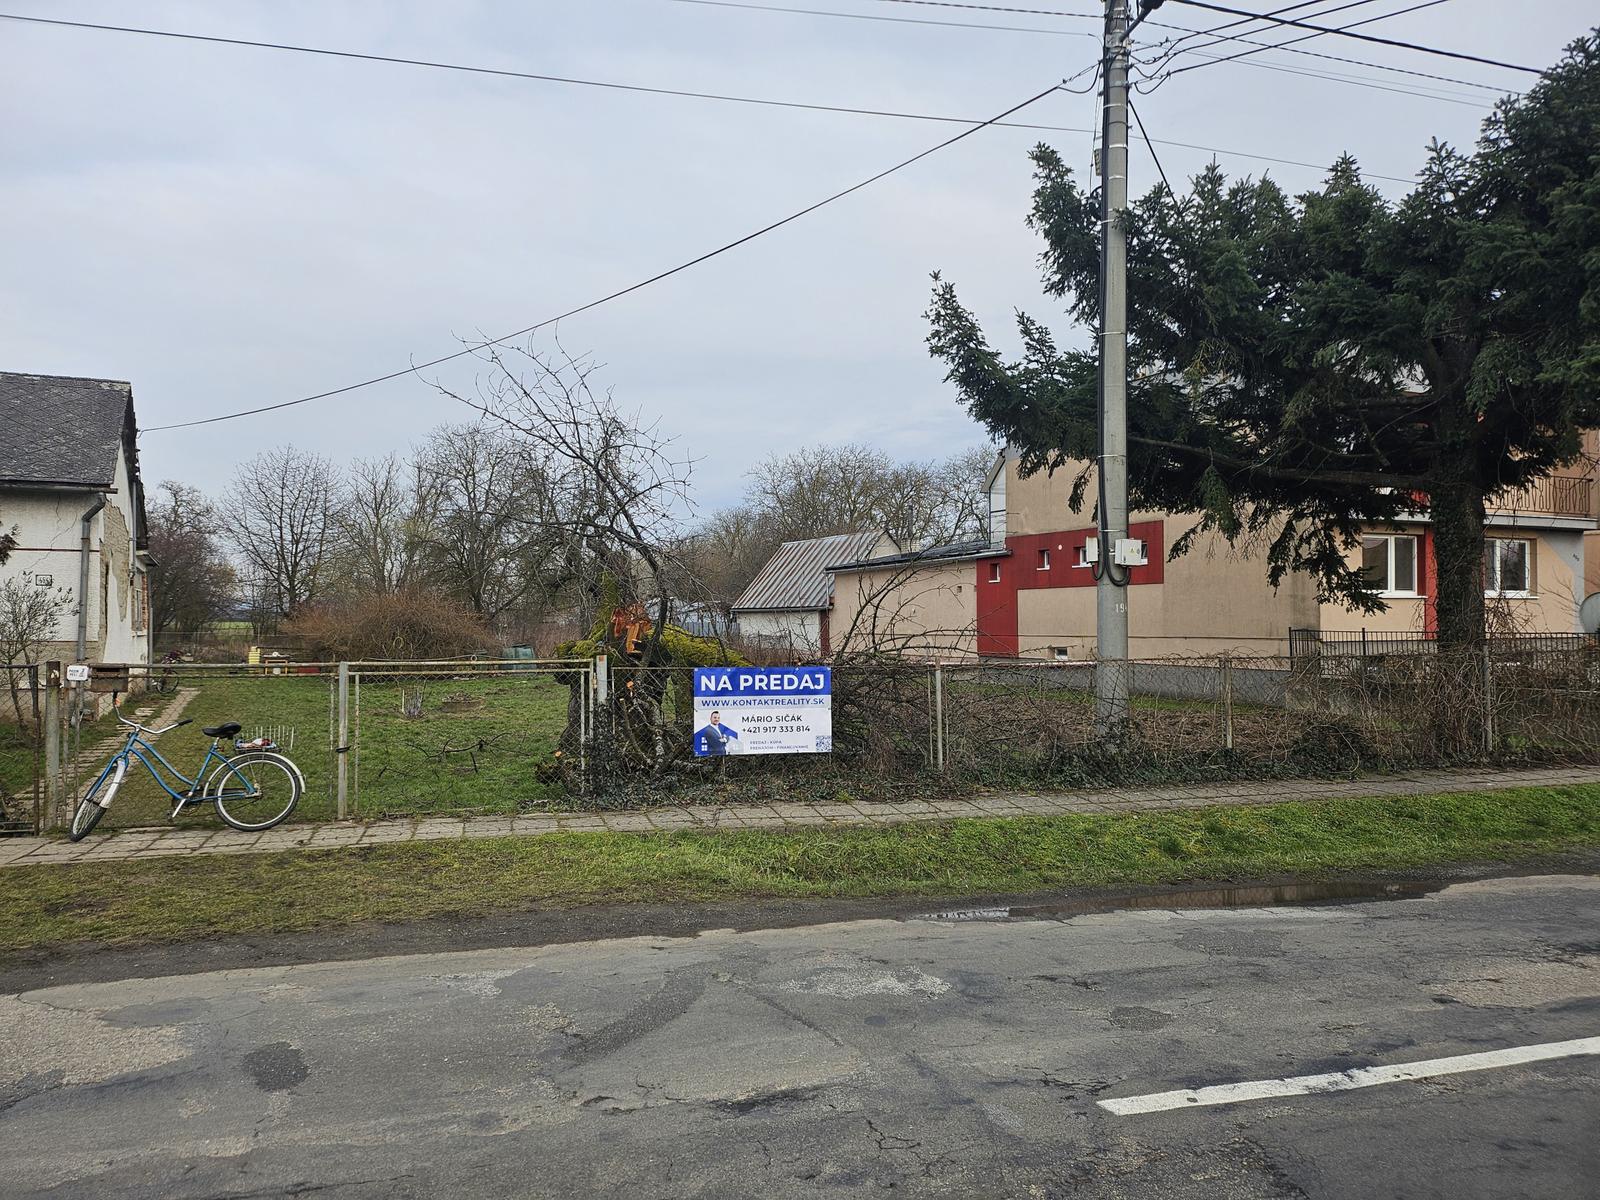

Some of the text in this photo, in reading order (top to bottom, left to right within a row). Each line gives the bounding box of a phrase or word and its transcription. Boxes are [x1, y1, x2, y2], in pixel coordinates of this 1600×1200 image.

[1115, 603, 1126, 613] 19
[701, 674, 824, 691] NA PREDAJ
[702, 698, 824, 707] WWW.KONTAKTREALITY.SK
[742, 714, 802, 723] MÁRIO SIČÁK
[779, 725, 794, 733] 333
[796, 725, 810, 733] 814
